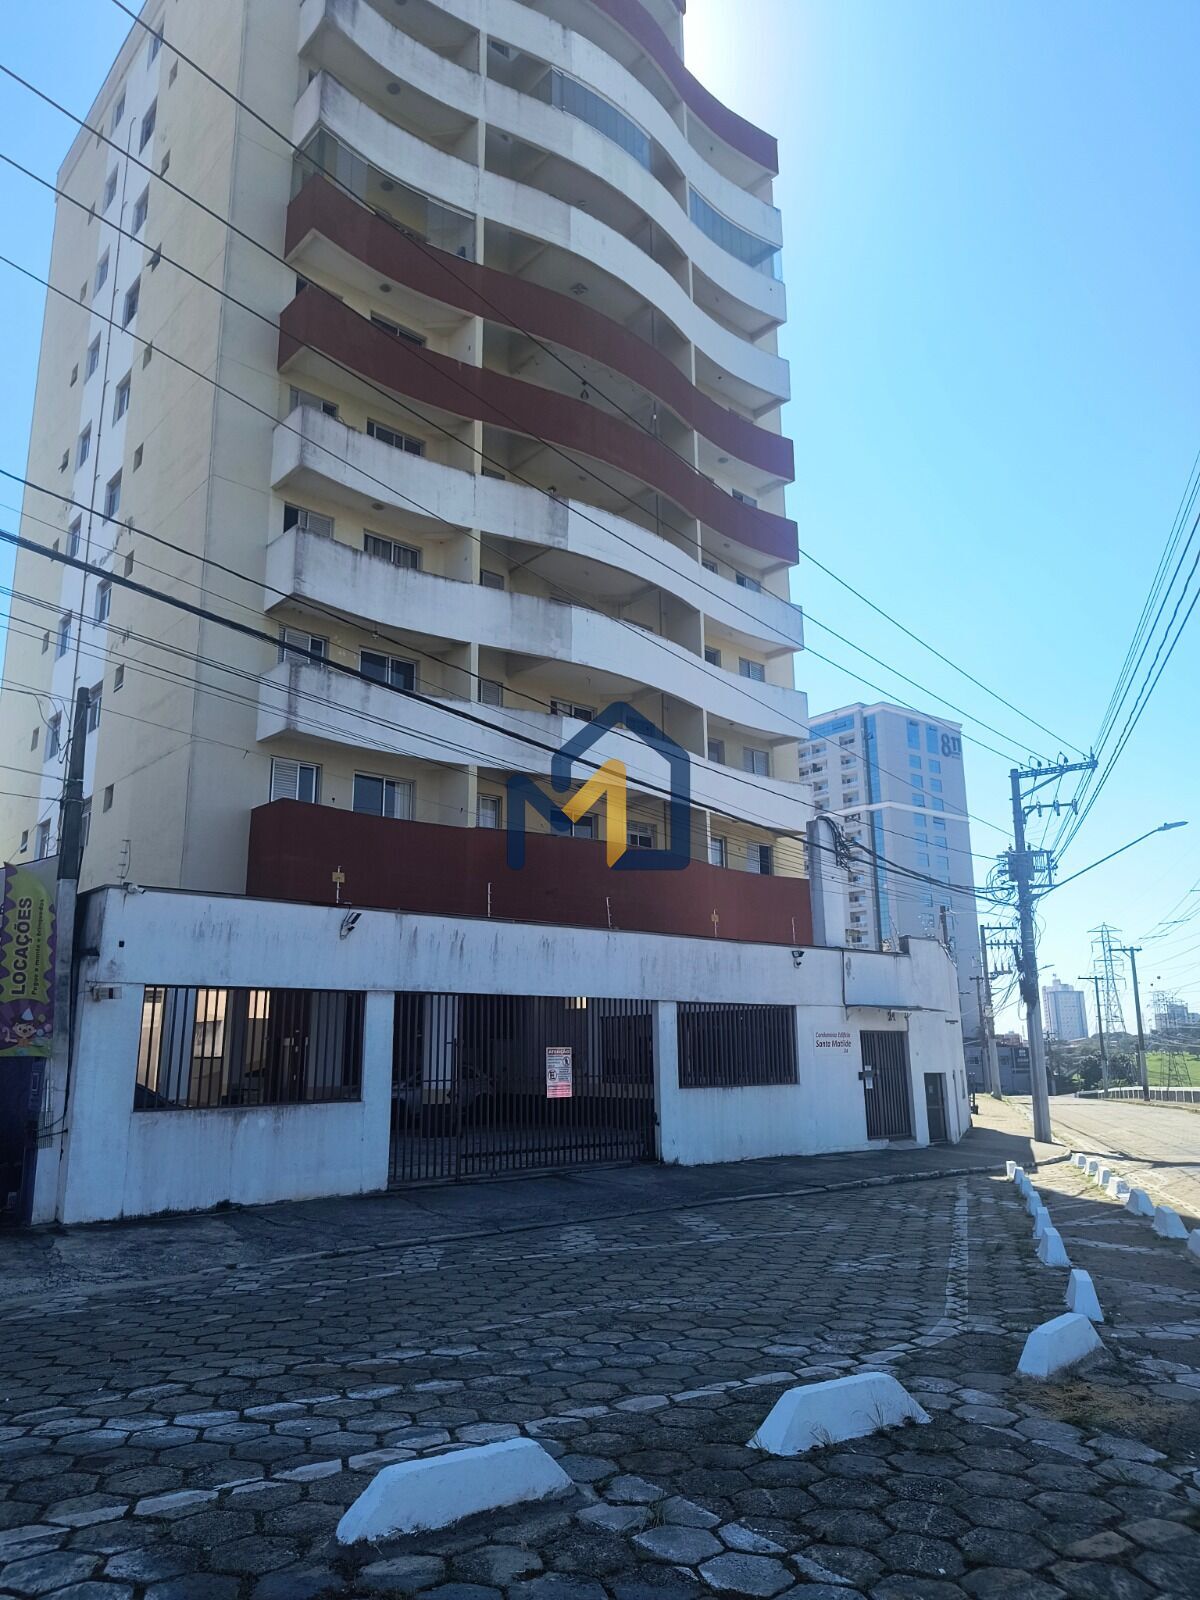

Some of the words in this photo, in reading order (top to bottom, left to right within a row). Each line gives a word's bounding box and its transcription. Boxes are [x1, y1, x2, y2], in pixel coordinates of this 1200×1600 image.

[11, 897, 32, 996] LOCAÇÕES
[815, 1040, 831, 1048] Santa
[832, 1040, 852, 1048] Matilde
